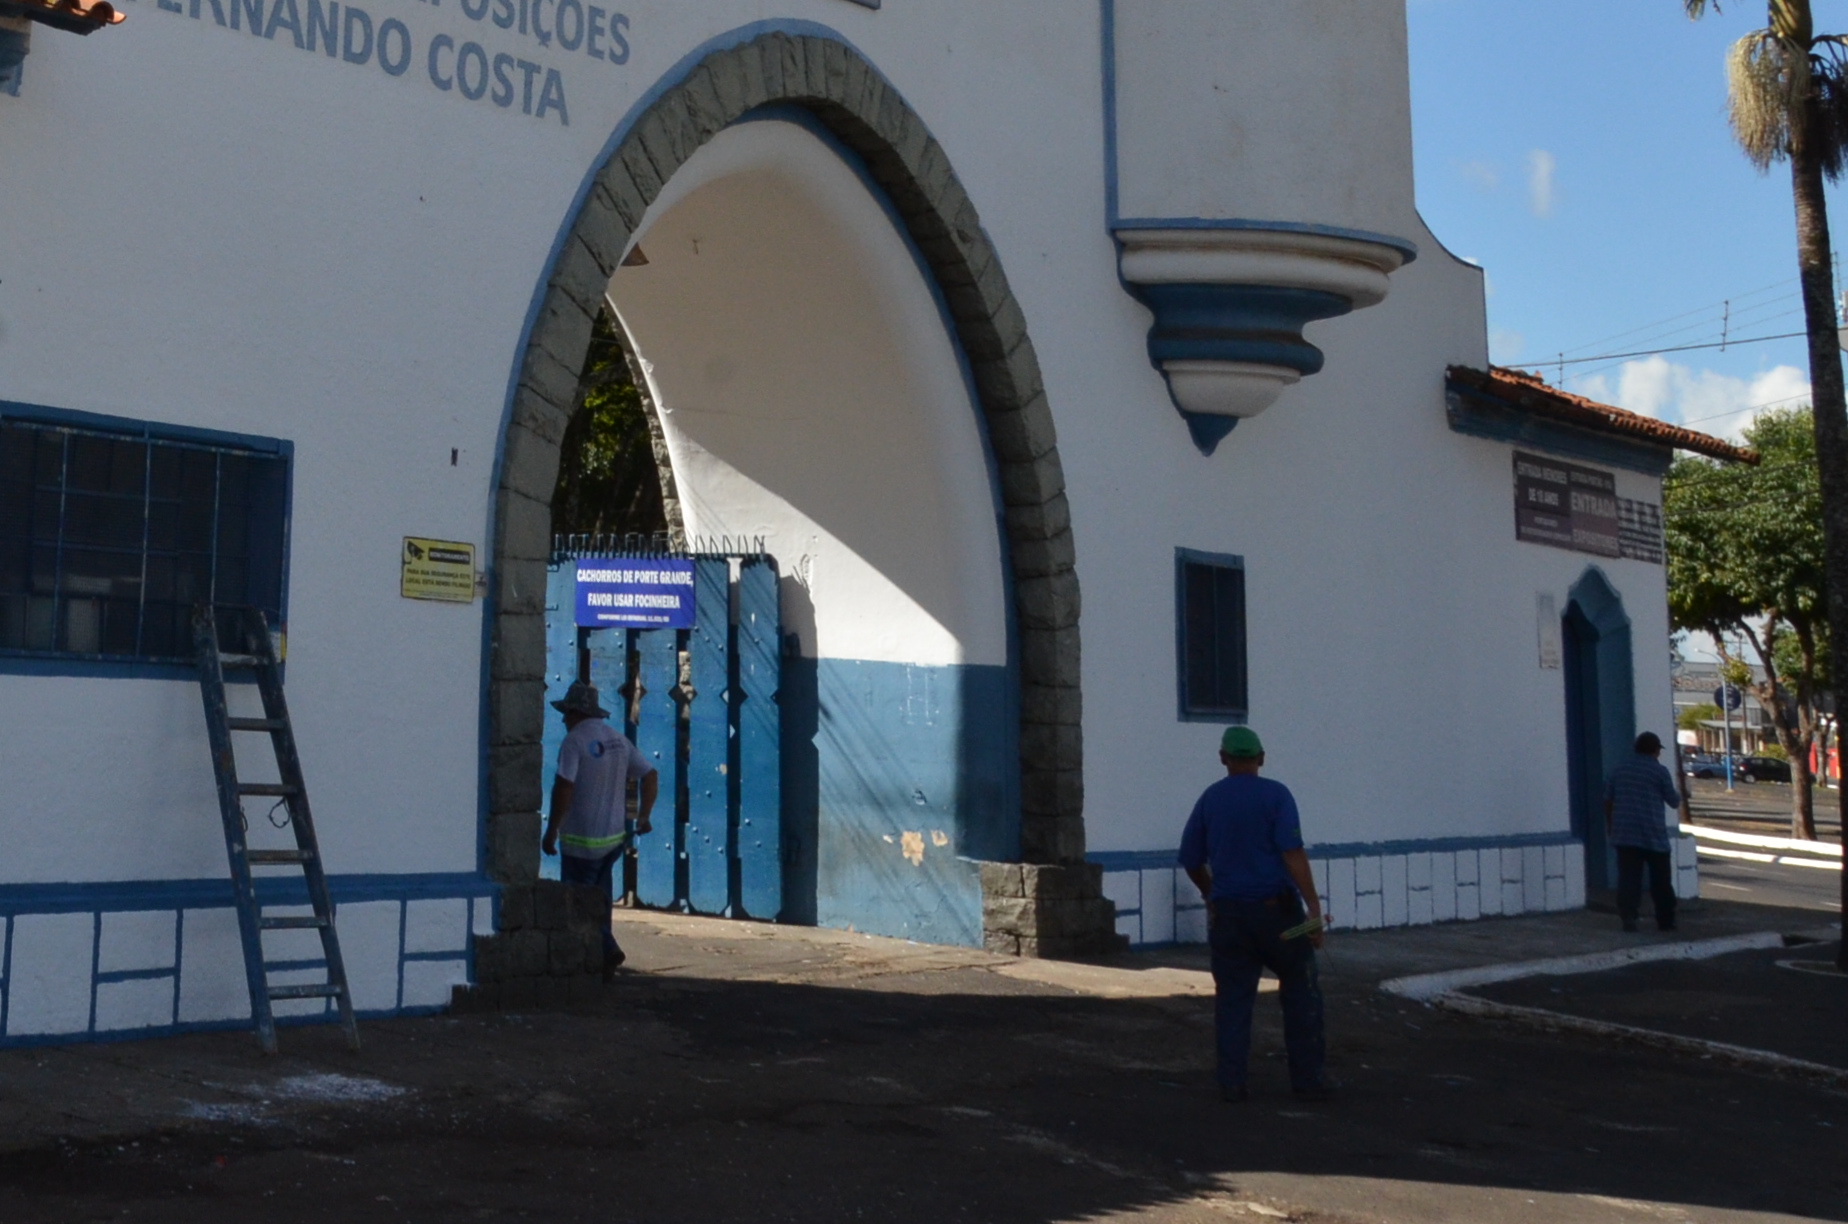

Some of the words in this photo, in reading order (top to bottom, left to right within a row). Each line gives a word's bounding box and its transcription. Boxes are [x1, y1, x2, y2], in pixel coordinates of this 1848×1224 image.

[428, 33, 570, 127] COSTA
[577, 569, 622, 583] CACHORROS
[623, 570, 633, 583] DE
[634, 570, 658, 584] PORTE
[660, 571, 694, 587] GRANDE,
[587, 592, 612, 607] FAVOR
[614, 593, 634, 607] USAR
[635, 594, 680, 609] FOCINHEIRA
